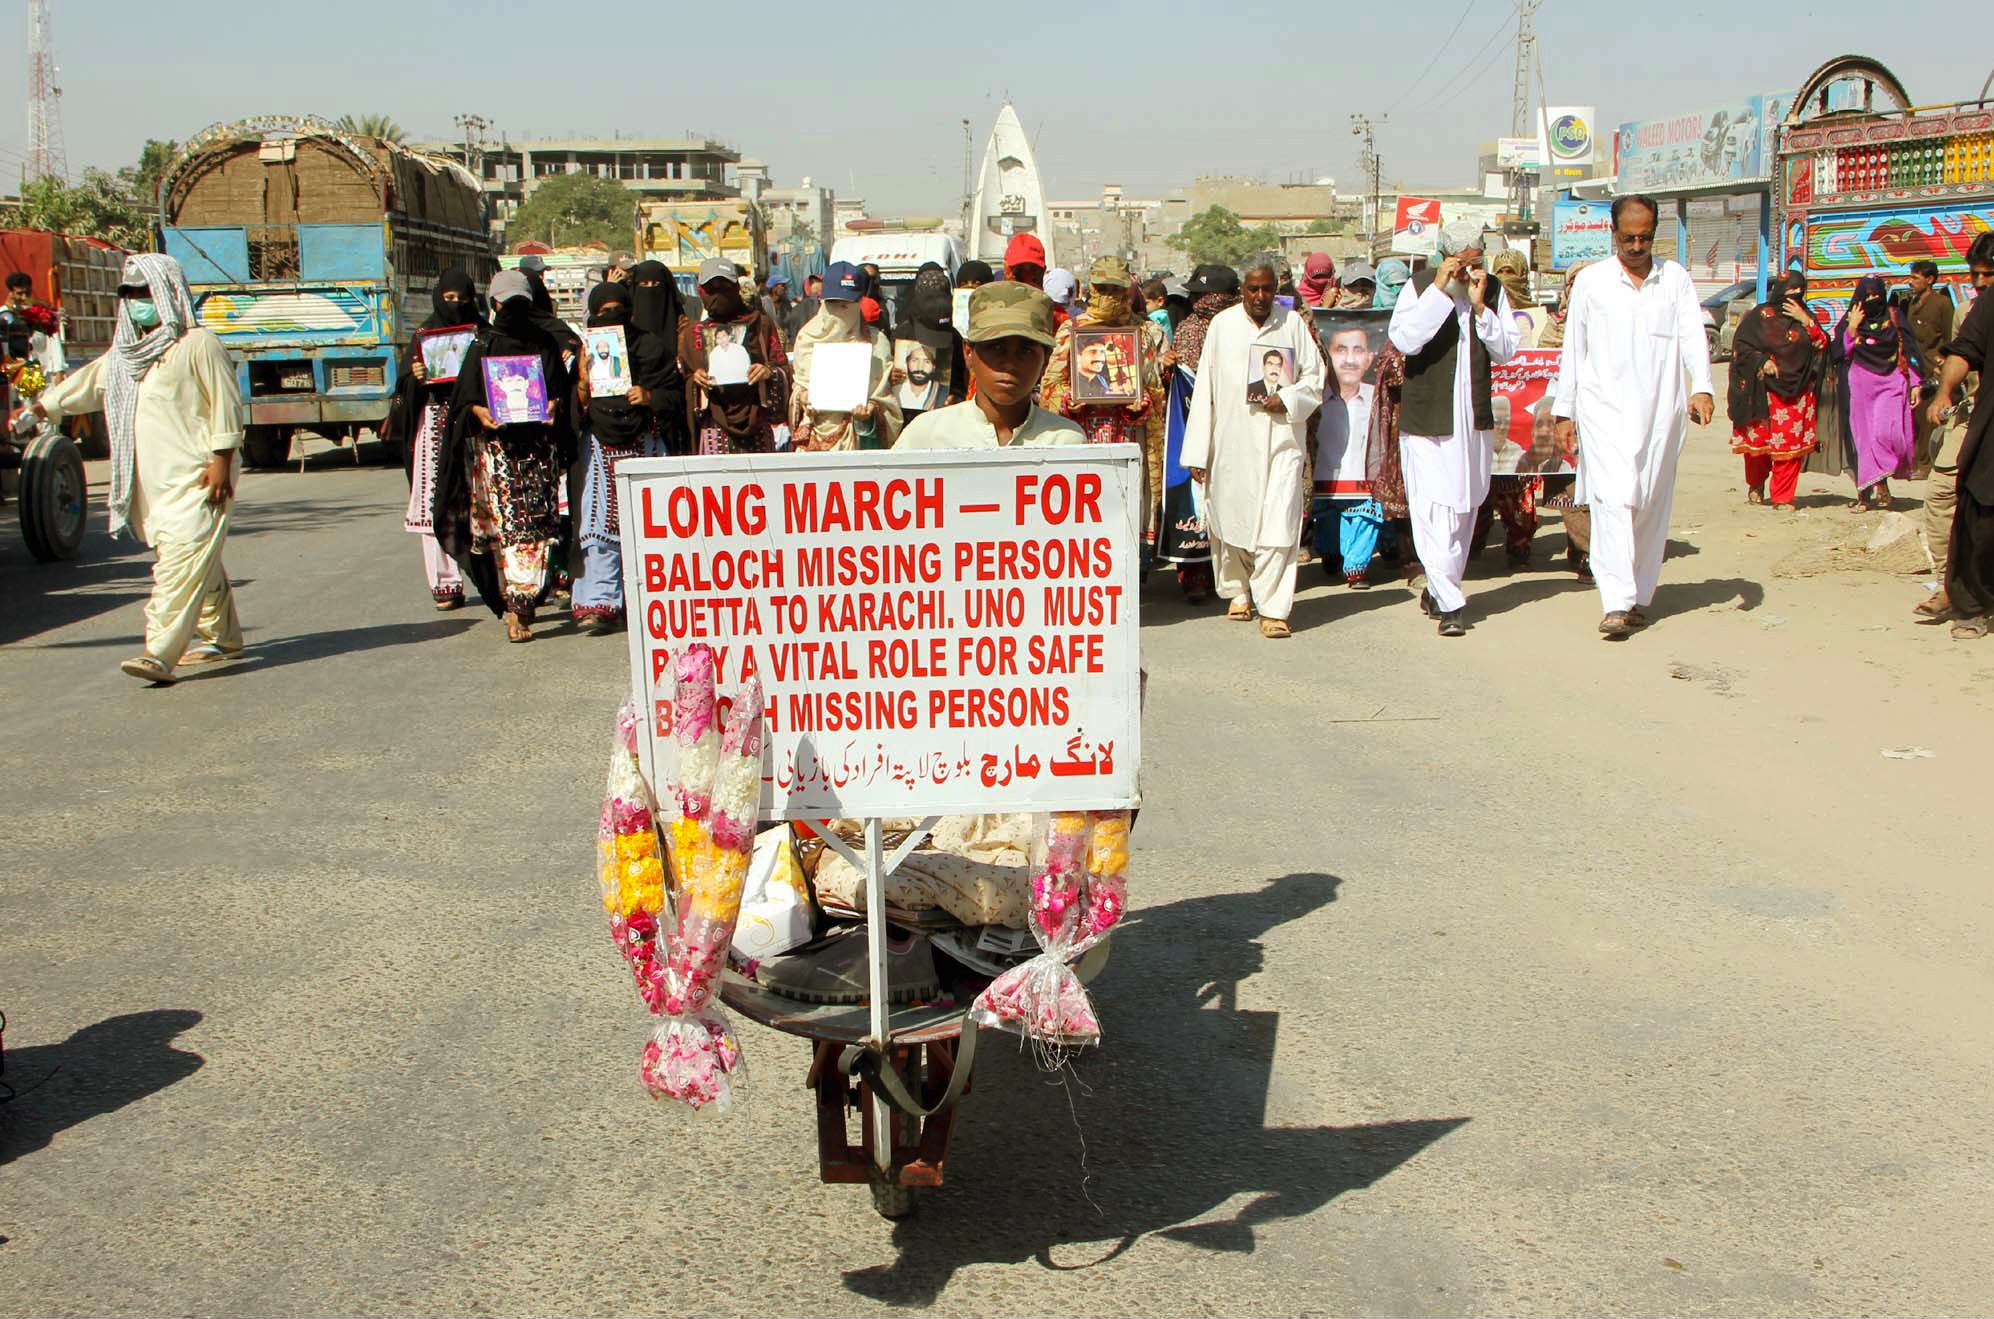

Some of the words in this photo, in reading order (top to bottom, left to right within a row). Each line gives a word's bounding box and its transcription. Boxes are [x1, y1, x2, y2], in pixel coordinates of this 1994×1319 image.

[1559, 126, 1585, 141] PSO
[1637, 122, 1665, 149] WALEED
[1666, 114, 1703, 146] MOTORS
[641, 484, 767, 539] LONG
[783, 477, 945, 535] MARCH
[1015, 473, 1103, 526] FOR
[644, 549, 785, 593] BALOCH
[797, 543, 942, 588] MISSING
[954, 538, 1113, 583] PERSONS
[647, 597, 763, 641] QUETTA
[769, 595, 808, 635] TO
[818, 589, 955, 633] KARACHI.
[965, 588, 1025, 629] UNO
[1043, 586, 1123, 627] MUST
[651, 644, 729, 685] PY
[740, 644, 759, 685] A
[768, 640, 859, 682] VITAL
[868, 638, 948, 679] ROLE
[958, 635, 1018, 677] FOR
[1028, 634, 1104, 675] SAFE
[655, 694, 779, 738] BOH
[789, 690, 918, 733] MISSING
[929, 687, 1070, 729] PERSONS
[931, 739, 972, 785] بلوچ
[980, 743, 1041, 788] مارچ
[1050, 735, 1114, 777] لانگ
